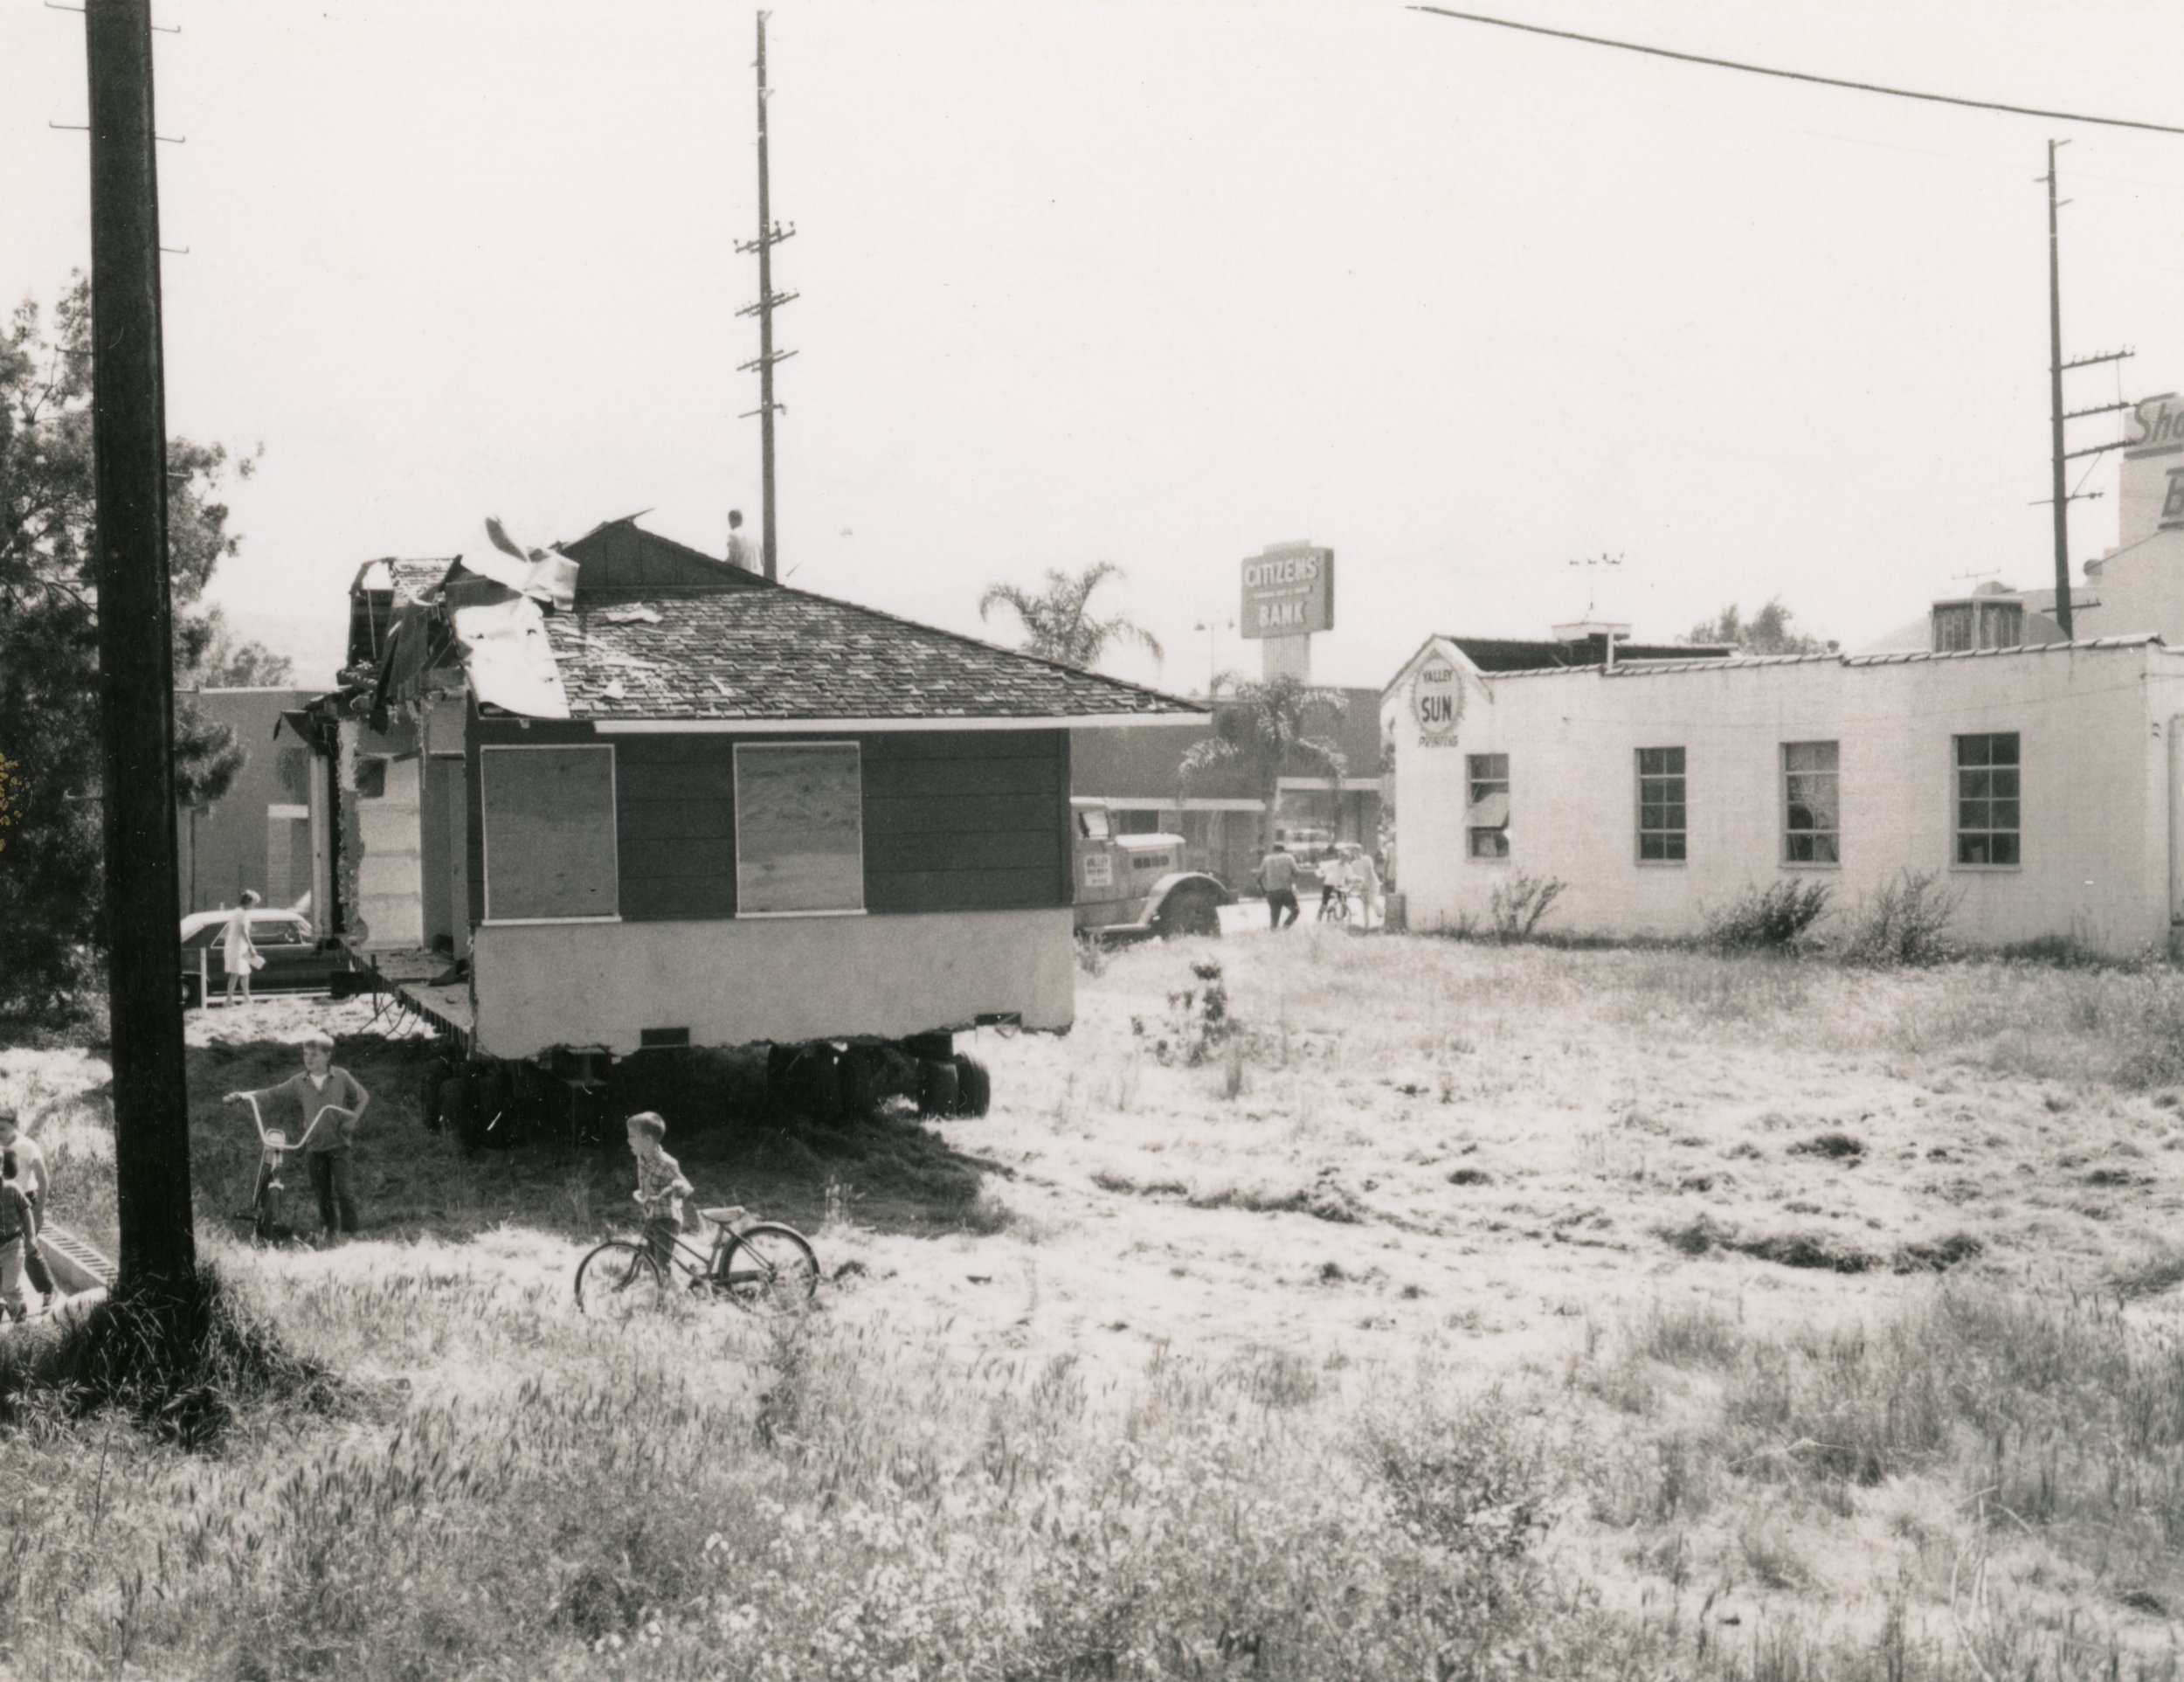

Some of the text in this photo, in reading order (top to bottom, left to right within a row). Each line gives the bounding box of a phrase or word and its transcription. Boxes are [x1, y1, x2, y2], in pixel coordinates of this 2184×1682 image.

[1244, 556, 1318, 587] CITIZENS
[1259, 600, 1306, 627] BANK
[1422, 669, 1453, 682] VALLEY
[1421, 696, 1451, 723] SUN
